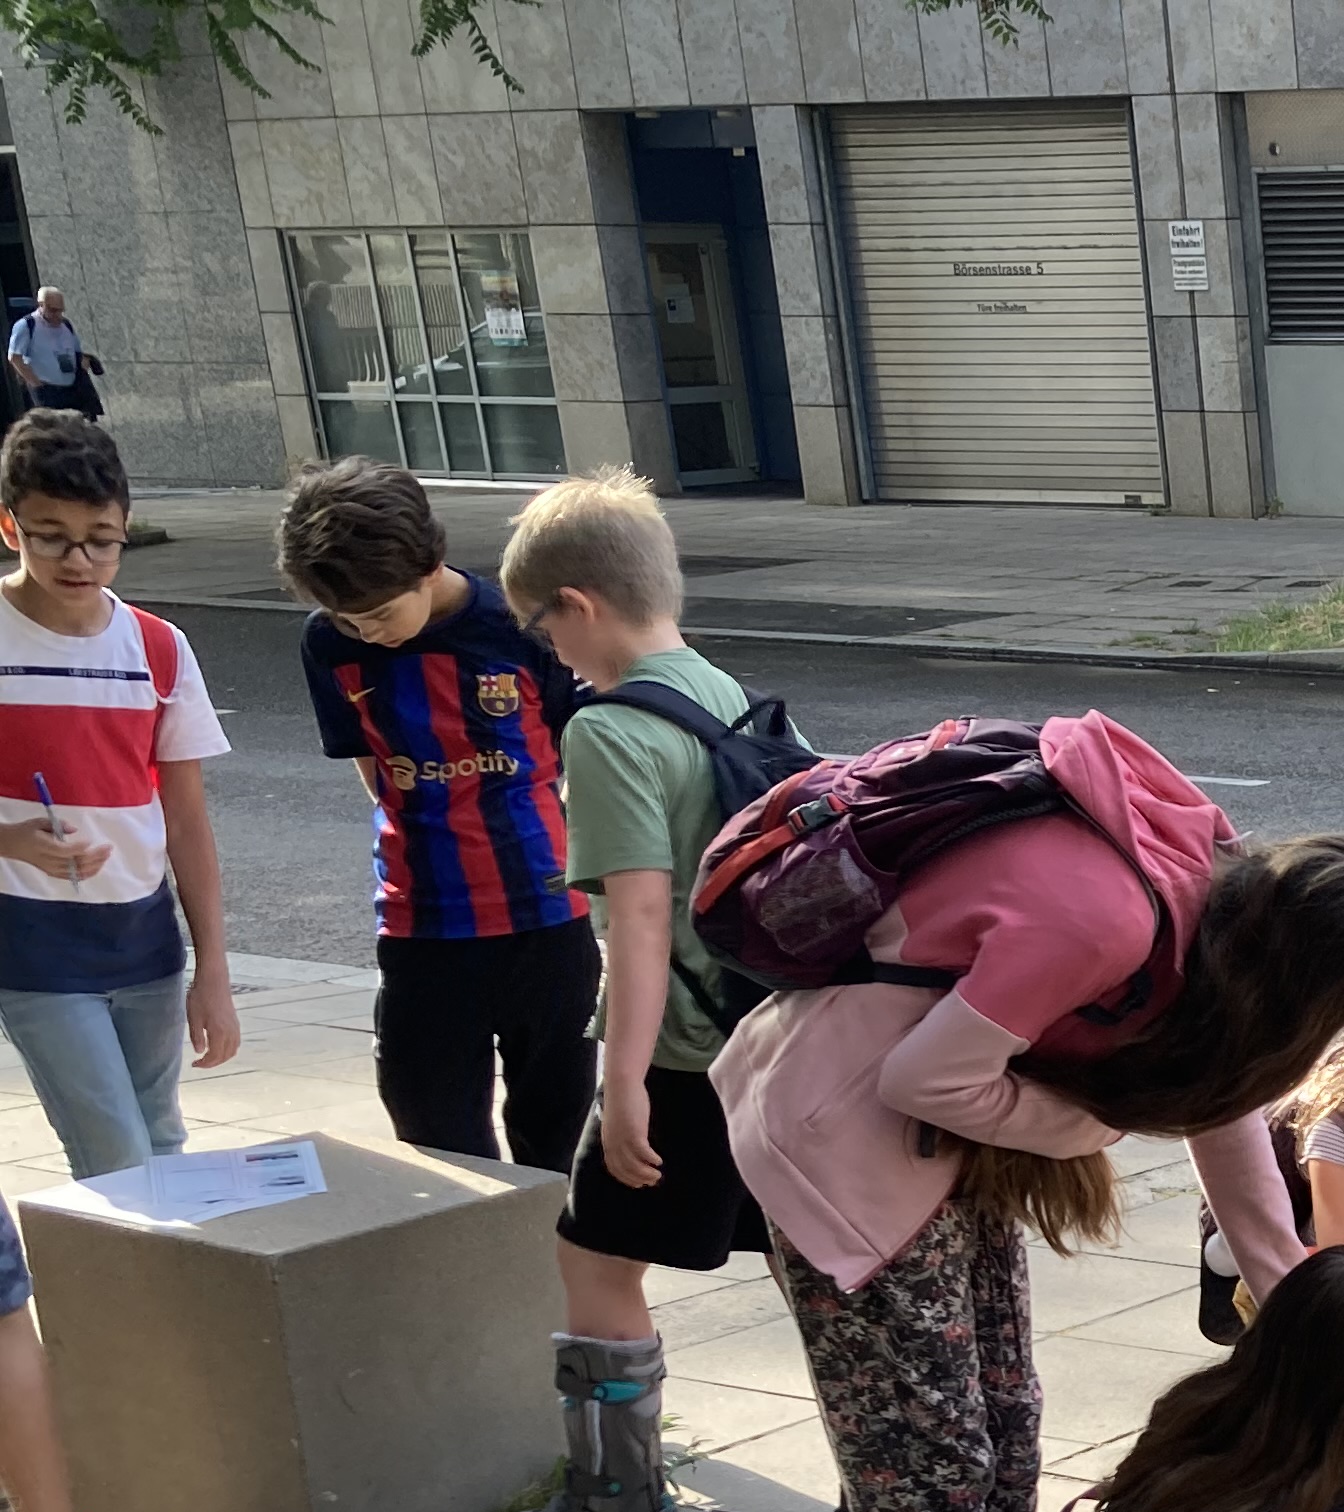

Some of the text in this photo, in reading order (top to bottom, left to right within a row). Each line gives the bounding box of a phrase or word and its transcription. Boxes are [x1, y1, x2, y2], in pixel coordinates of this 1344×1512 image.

[1171, 225, 1200, 236] Einfahrt
[953, 262, 1044, 276] Börsenstrasse 5
[420, 750, 519, 784] Spotify
